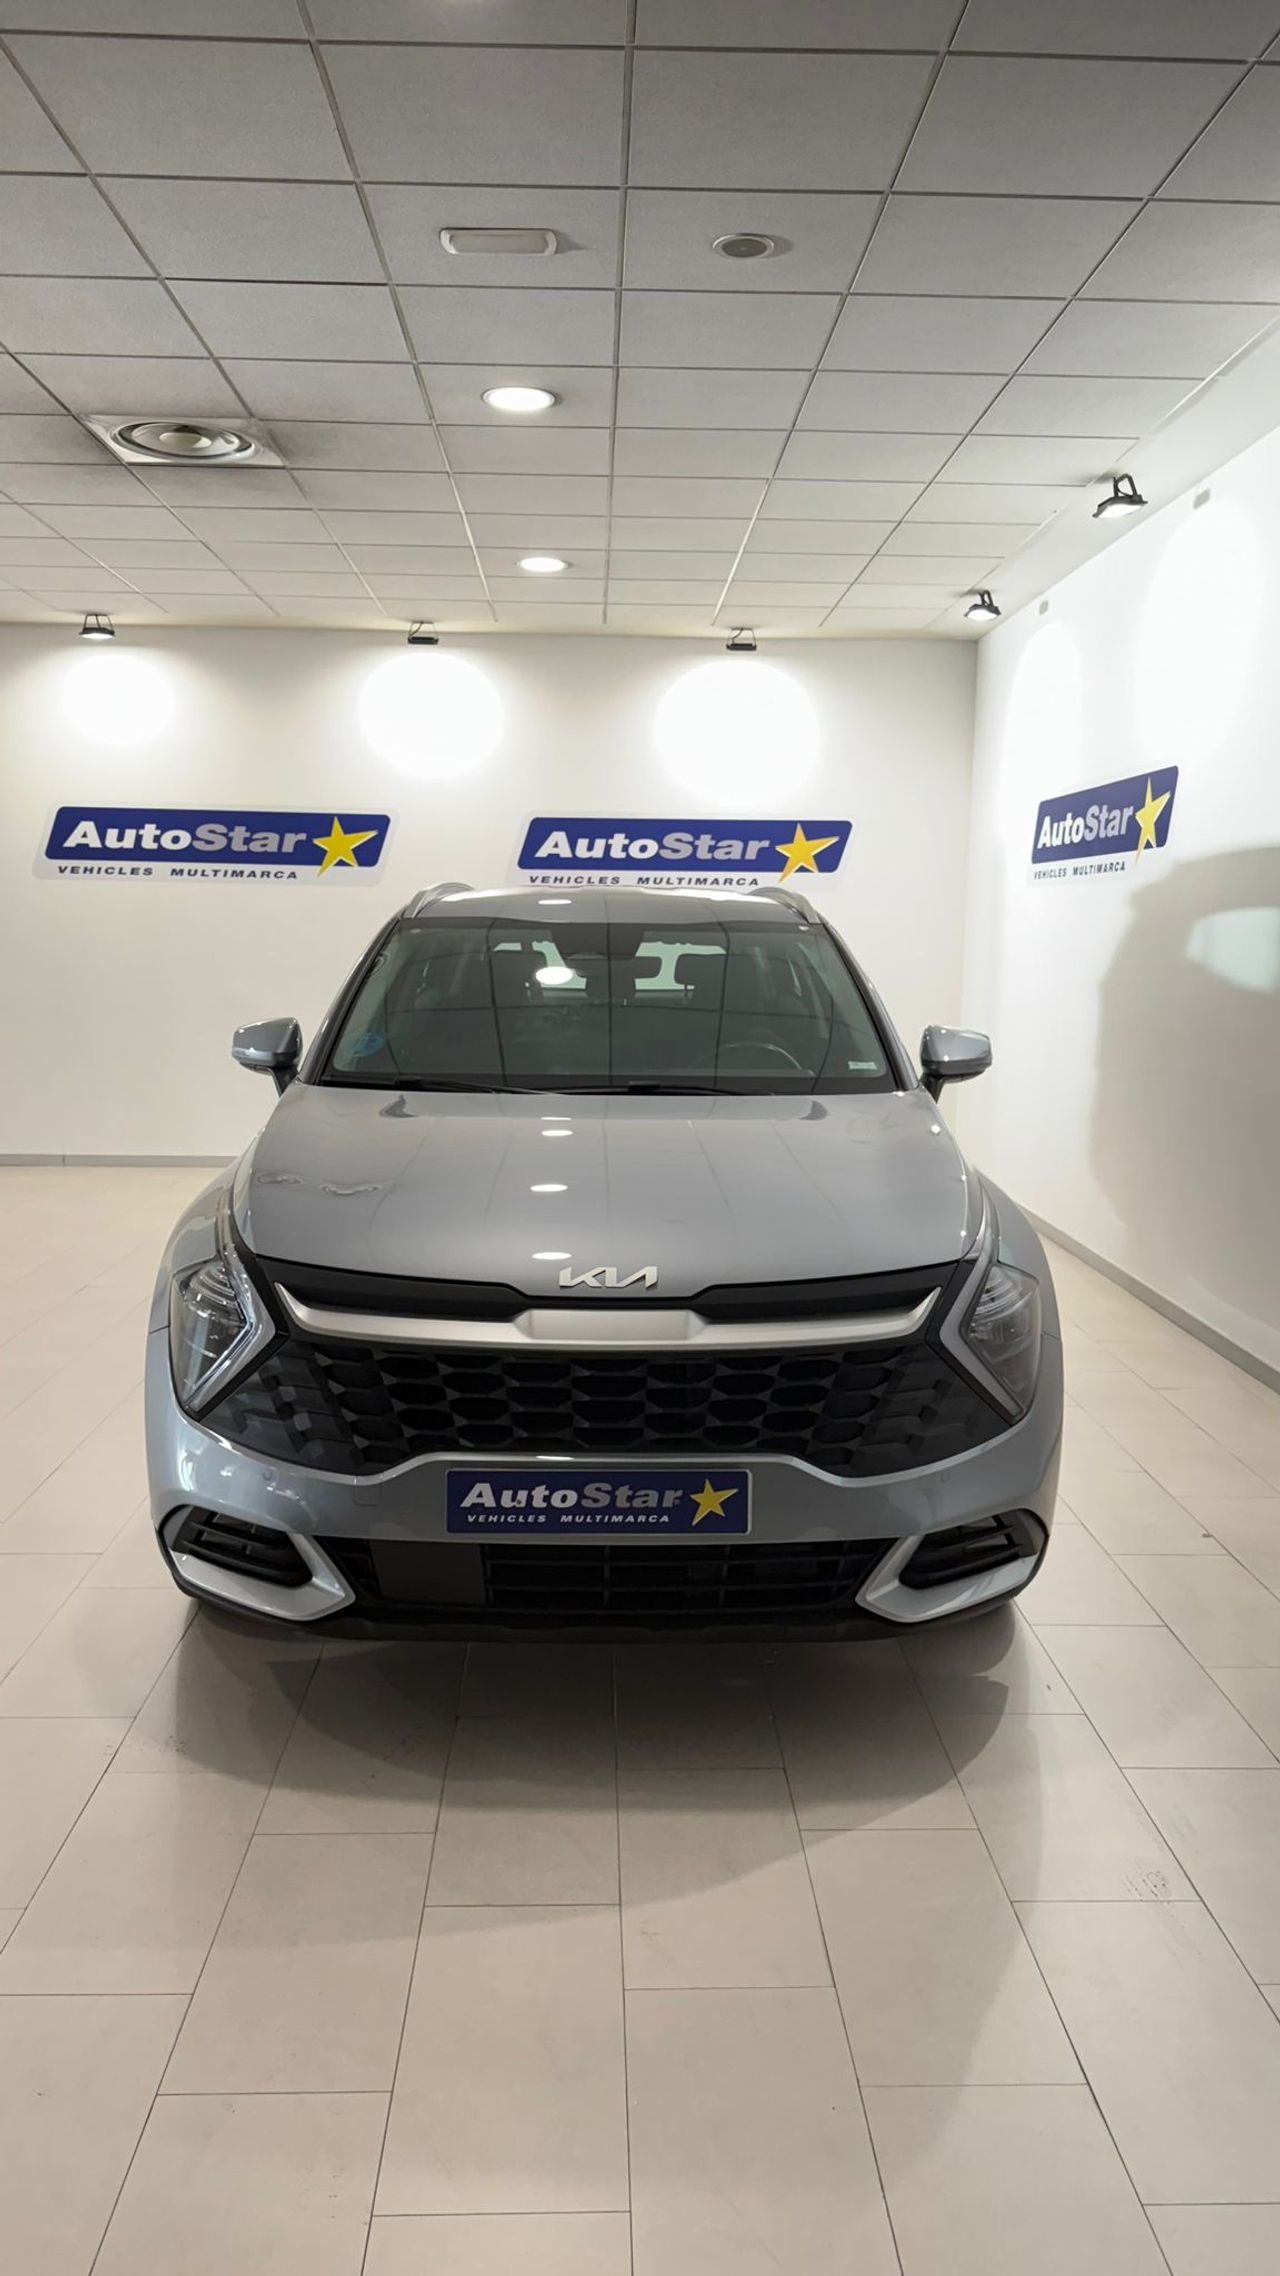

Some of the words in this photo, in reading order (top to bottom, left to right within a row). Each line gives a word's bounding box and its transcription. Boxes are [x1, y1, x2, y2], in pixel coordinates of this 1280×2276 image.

[62, 820, 306, 854] AutoStar
[1037, 805, 1133, 849] AutoStar
[534, 830, 769, 861] AutoStar
[57, 865, 154, 877] VEHICLES
[170, 868, 298, 880] MULTIMARCA
[529, 875, 621, 885] VEHICLES
[637, 876, 760, 886] MULTIMARCA
[1034, 868, 1067, 880] VEHICLES
[1073, 862, 1126, 875] MULTIMARCA
[460, 1482, 682, 1508] AutoStar
[467, 1514, 547, 1523] VEHICLES
[560, 1514, 670, 1523] MULTIMARCA
